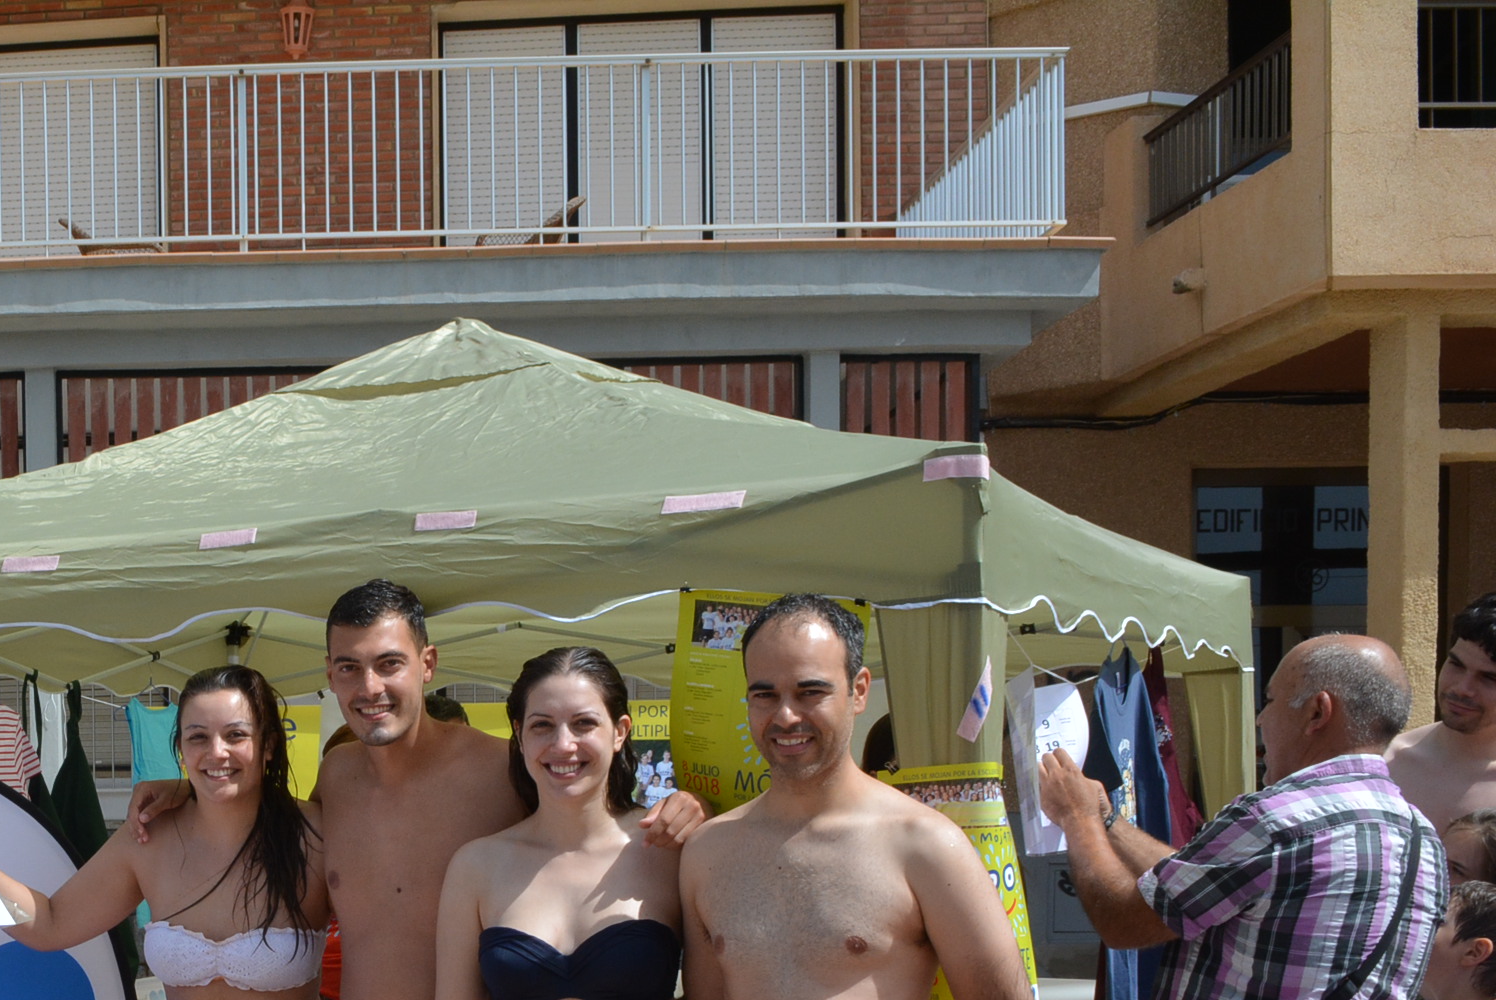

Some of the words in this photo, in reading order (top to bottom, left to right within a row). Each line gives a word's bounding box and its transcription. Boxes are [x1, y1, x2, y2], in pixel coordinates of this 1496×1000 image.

[1195, 507, 1298, 533] EDIFIO
[1316, 507, 1369, 532] PRIN
[638, 705, 669, 718] POR
[630, 724, 670, 738] ULTIPL
[681, 760, 688, 771] 8
[691, 762, 720, 777] JULIO
[683, 773, 721, 796] 2018
[734, 768, 772, 794] MÓ
